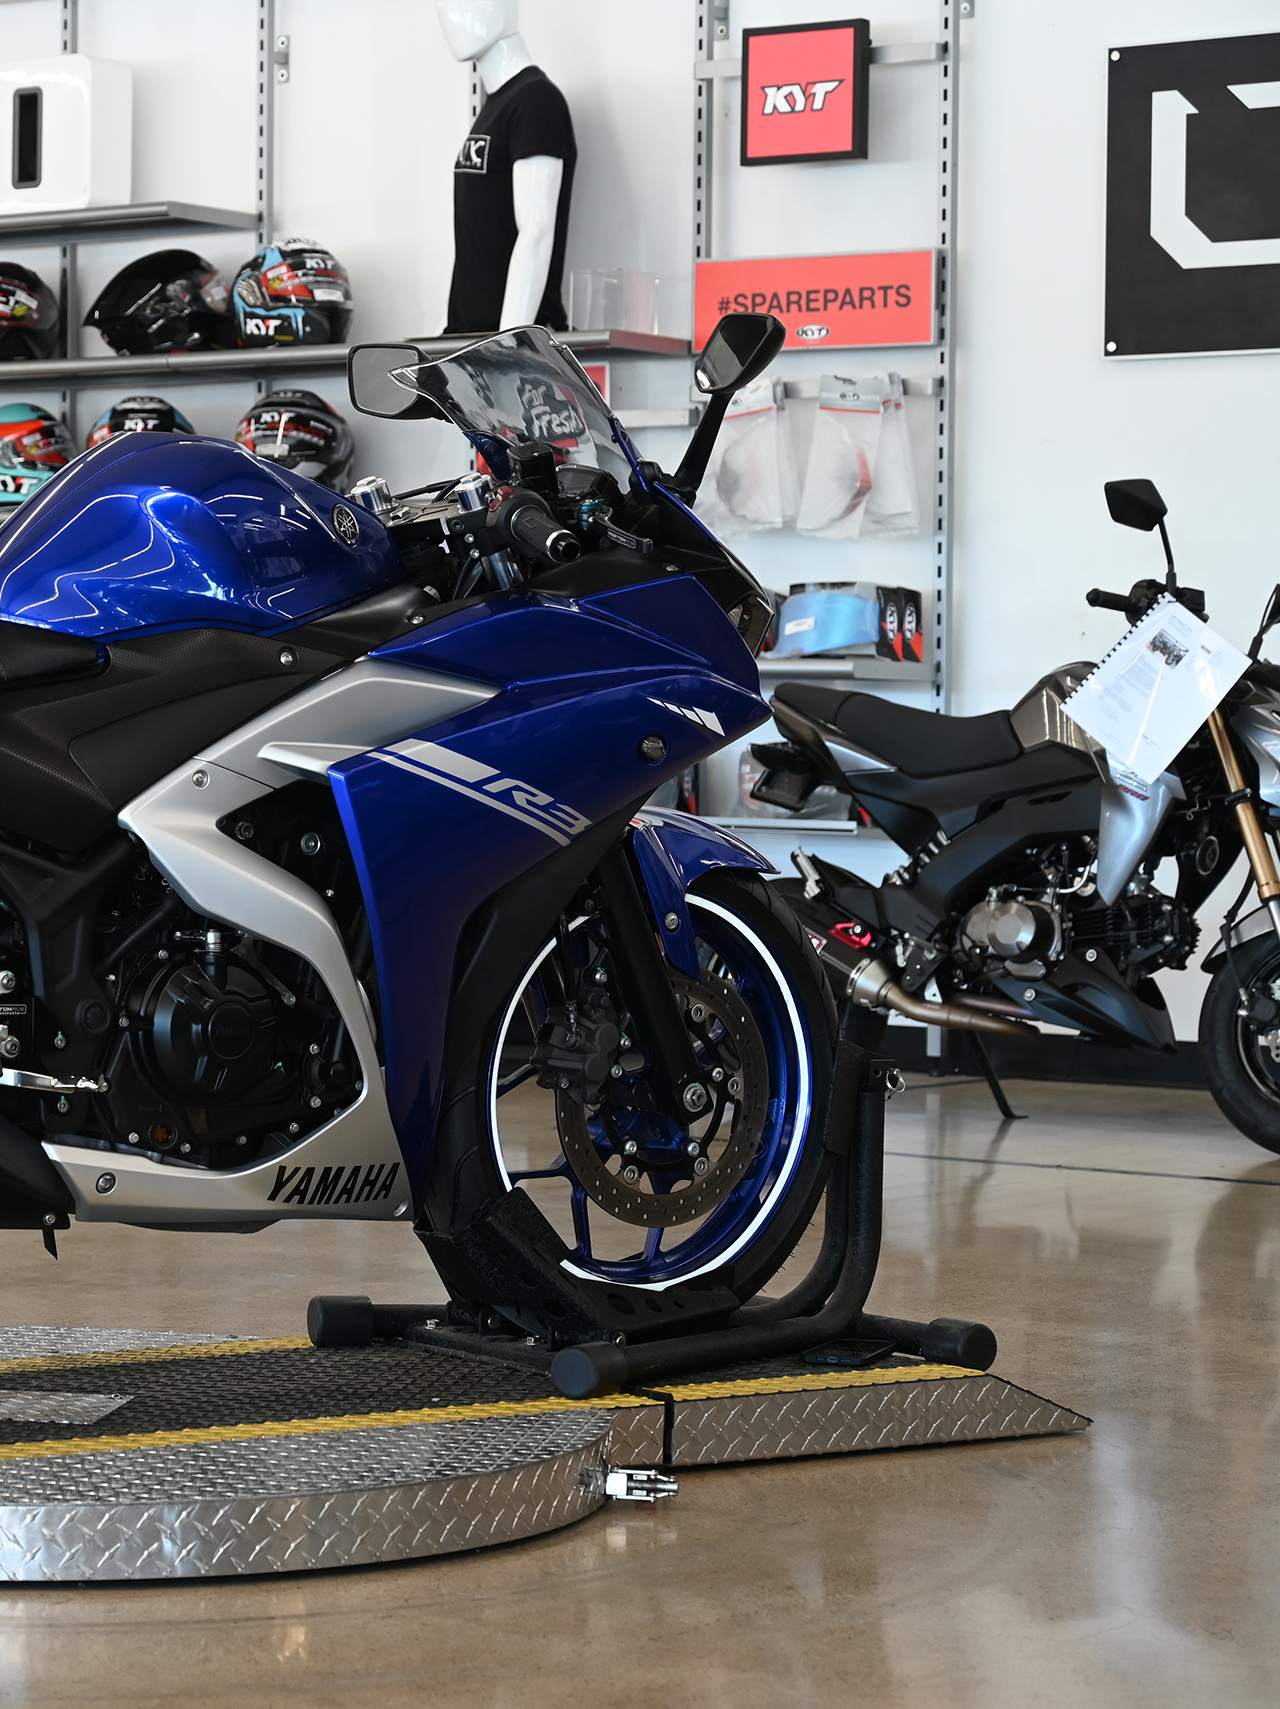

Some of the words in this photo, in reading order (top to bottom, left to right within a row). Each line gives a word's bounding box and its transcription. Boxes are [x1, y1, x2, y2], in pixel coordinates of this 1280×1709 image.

[760, 79, 846, 116] KYT
[305, 258, 335, 270] KYT
[718, 284, 912, 314] #SPAREPARTS
[245, 318, 282, 336] KYT
[123, 419, 160, 431] KYT
[482, 777, 593, 835] R3
[266, 1161, 401, 1205] YAMAHA
